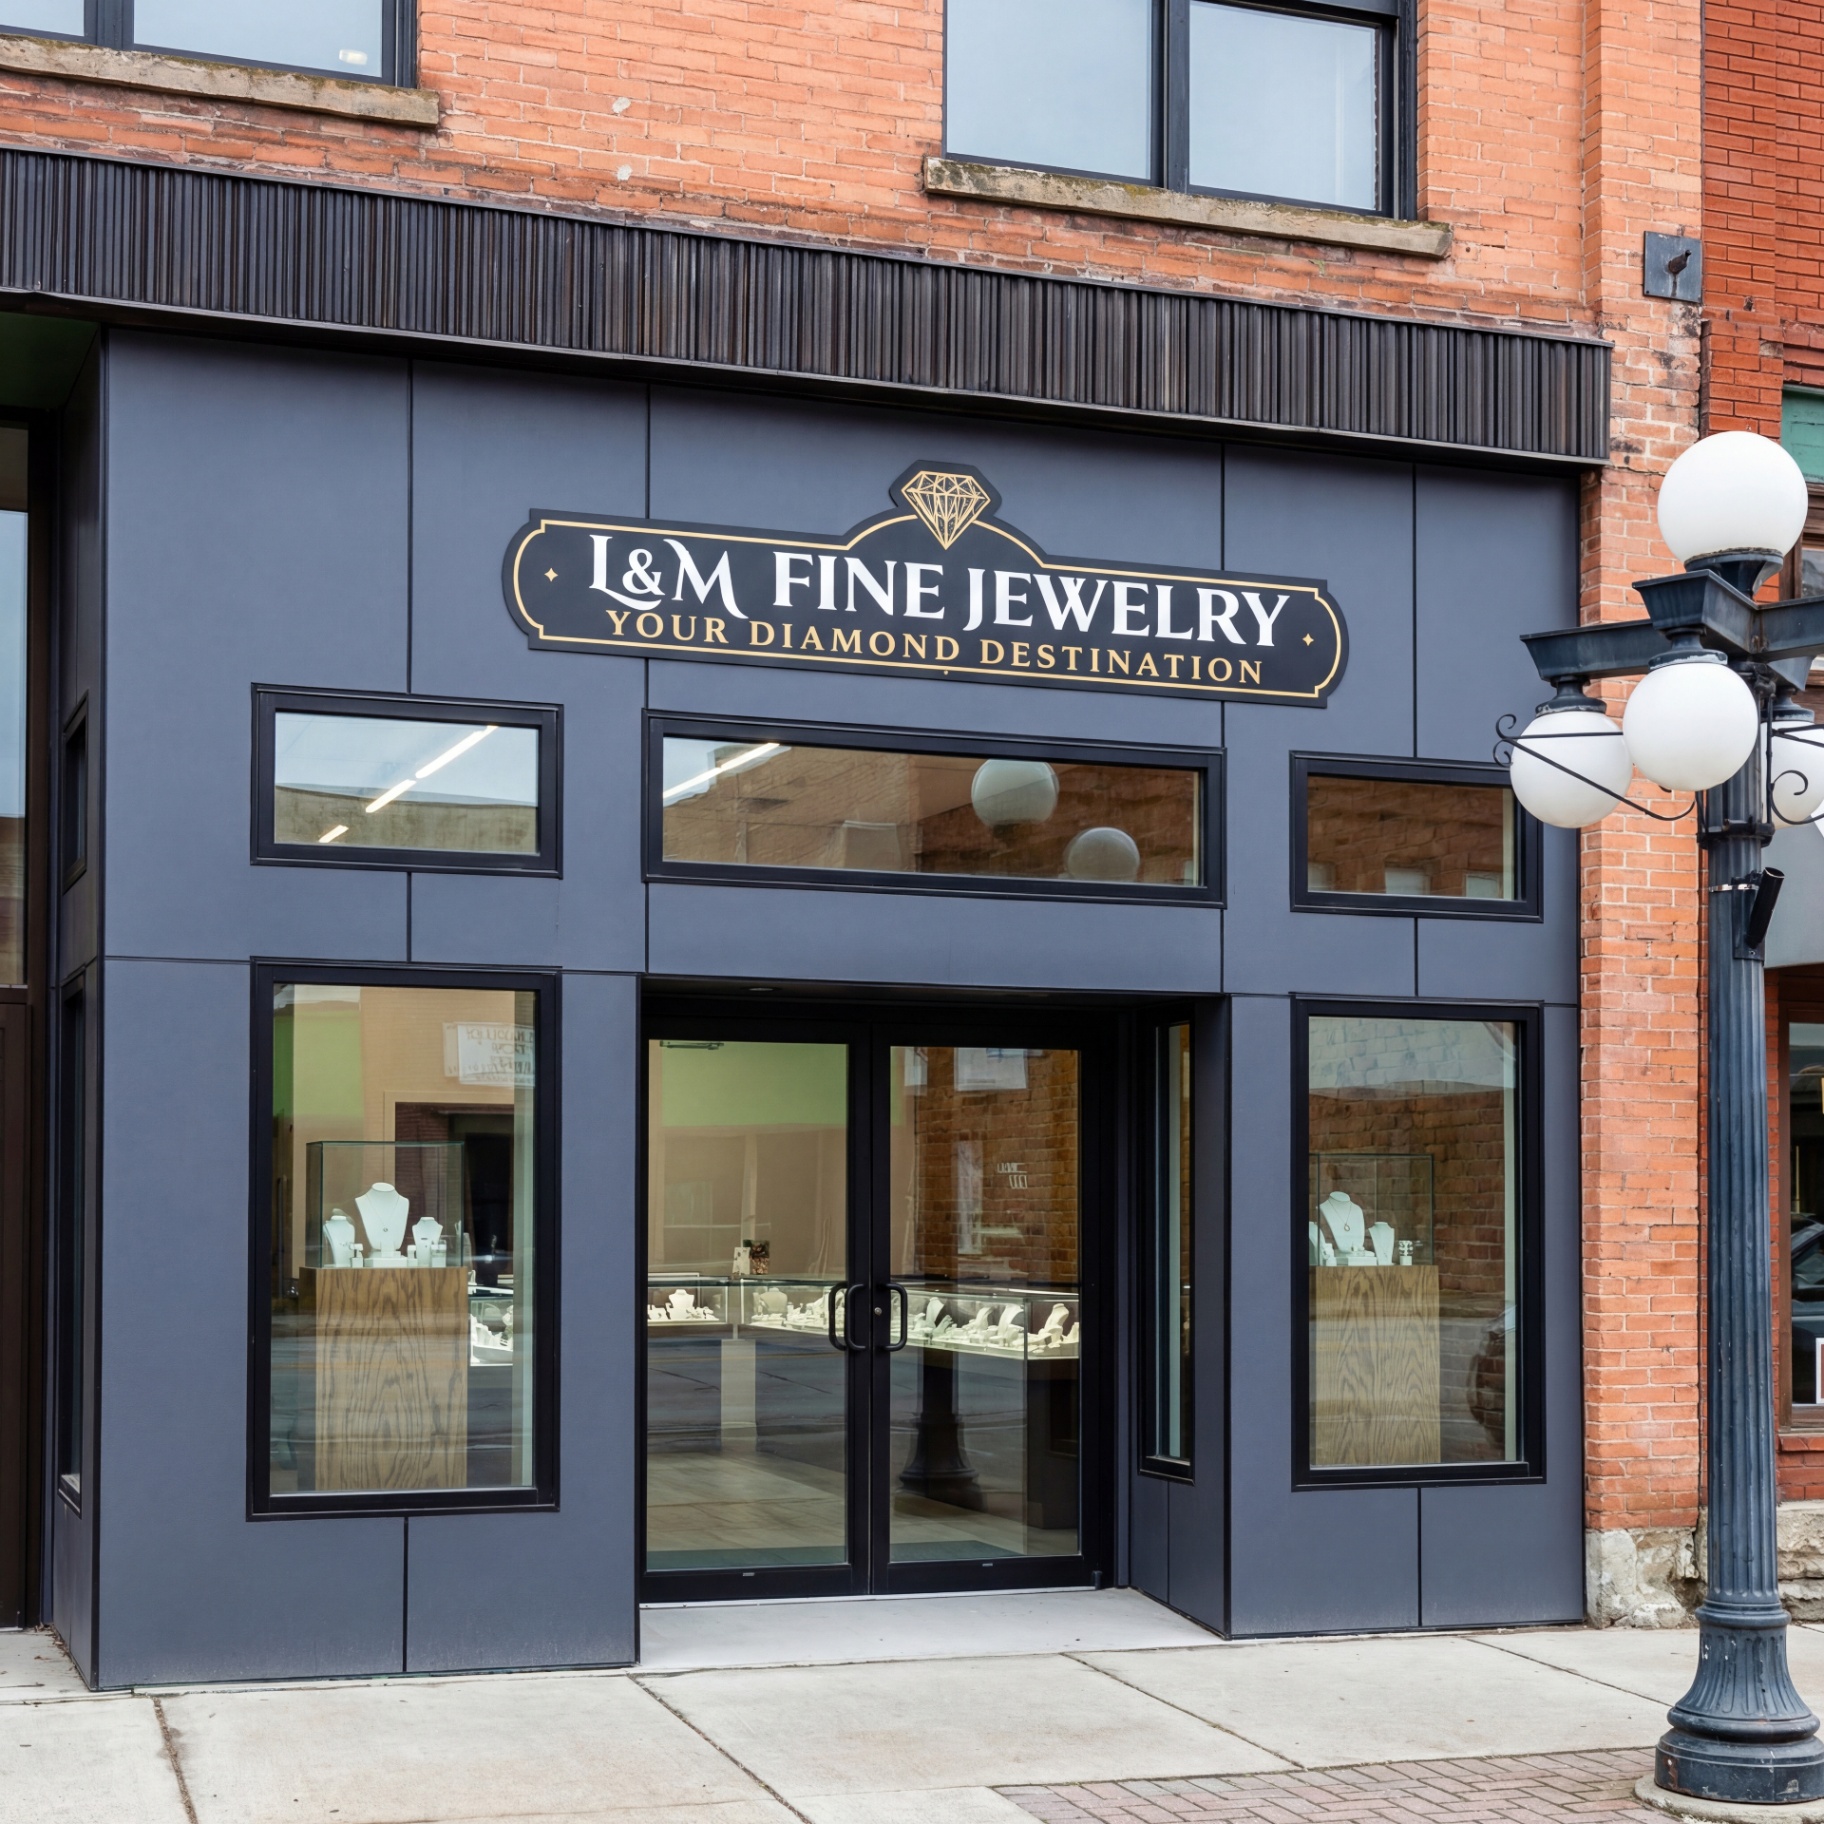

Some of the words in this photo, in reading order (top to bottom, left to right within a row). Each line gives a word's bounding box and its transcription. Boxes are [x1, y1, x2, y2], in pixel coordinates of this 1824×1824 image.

[588, 534, 749, 620] L&M
[772, 551, 946, 620] FINE
[962, 567, 1291, 648] JEWELRY
[606, 609, 730, 644] YOUR
[749, 621, 961, 661] DIAMOND
[980, 638, 1263, 685] DESTINATION
